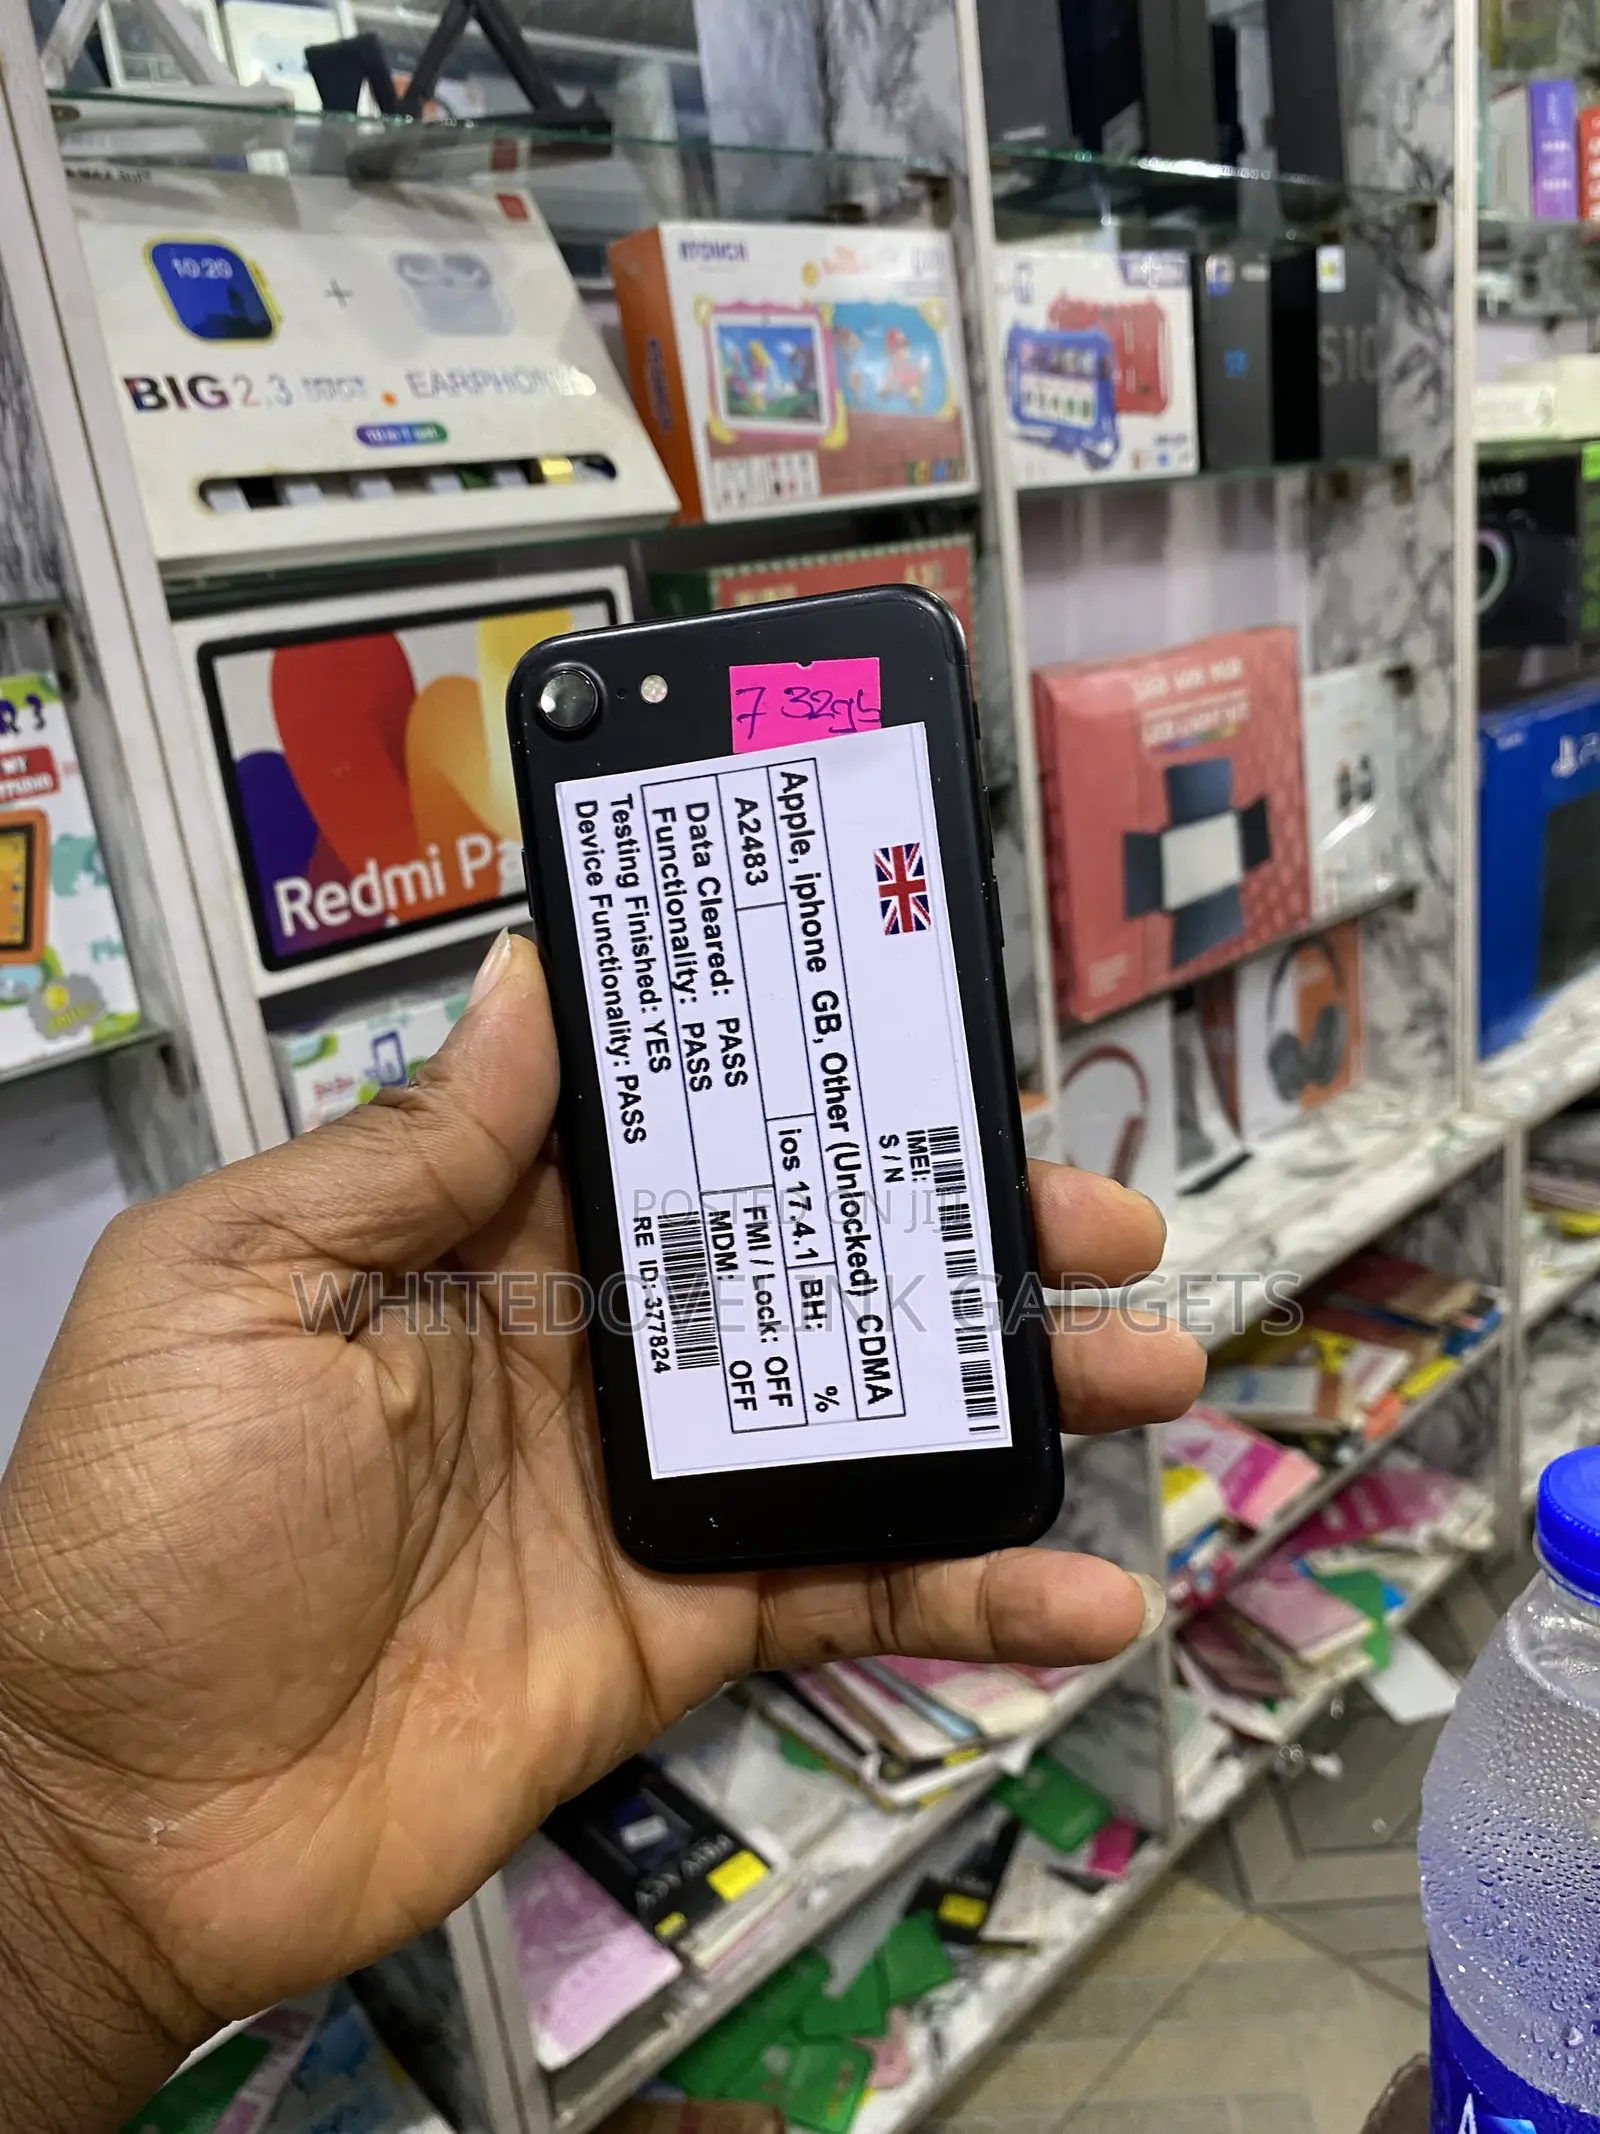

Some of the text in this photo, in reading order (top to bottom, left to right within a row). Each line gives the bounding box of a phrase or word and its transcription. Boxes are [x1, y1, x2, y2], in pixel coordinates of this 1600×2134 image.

[124, 375, 230, 413] BIG
[734, 797, 769, 887] A2483
[273, 843, 446, 937] Redmi
[610, 793, 672, 1074] Testing Finished: YES
[575, 800, 647, 1144] Device Functionality: PASS
[652, 806, 713, 1092] Functionality: PASS
[685, 802, 749, 1088] Data Cleared: PASS
[777, 771, 893, 1405] Apple, iphone GB, Other (Unlocked) CDMA
[778, 1128, 819, 1260] ios 17.4.1
[906, 1130, 931, 1182] IMEI:
[743, 1206, 772, 1251] FMI
[633, 1216, 672, 1374] RE ID: 377824
[708, 1210, 758, 1411] MDM: OFF
[752, 1273, 782, 1343] Lock:
[800, 1279, 828, 1330] BH:
[764, 1356, 793, 1408] OFF
[813, 1385, 840, 1413] %
